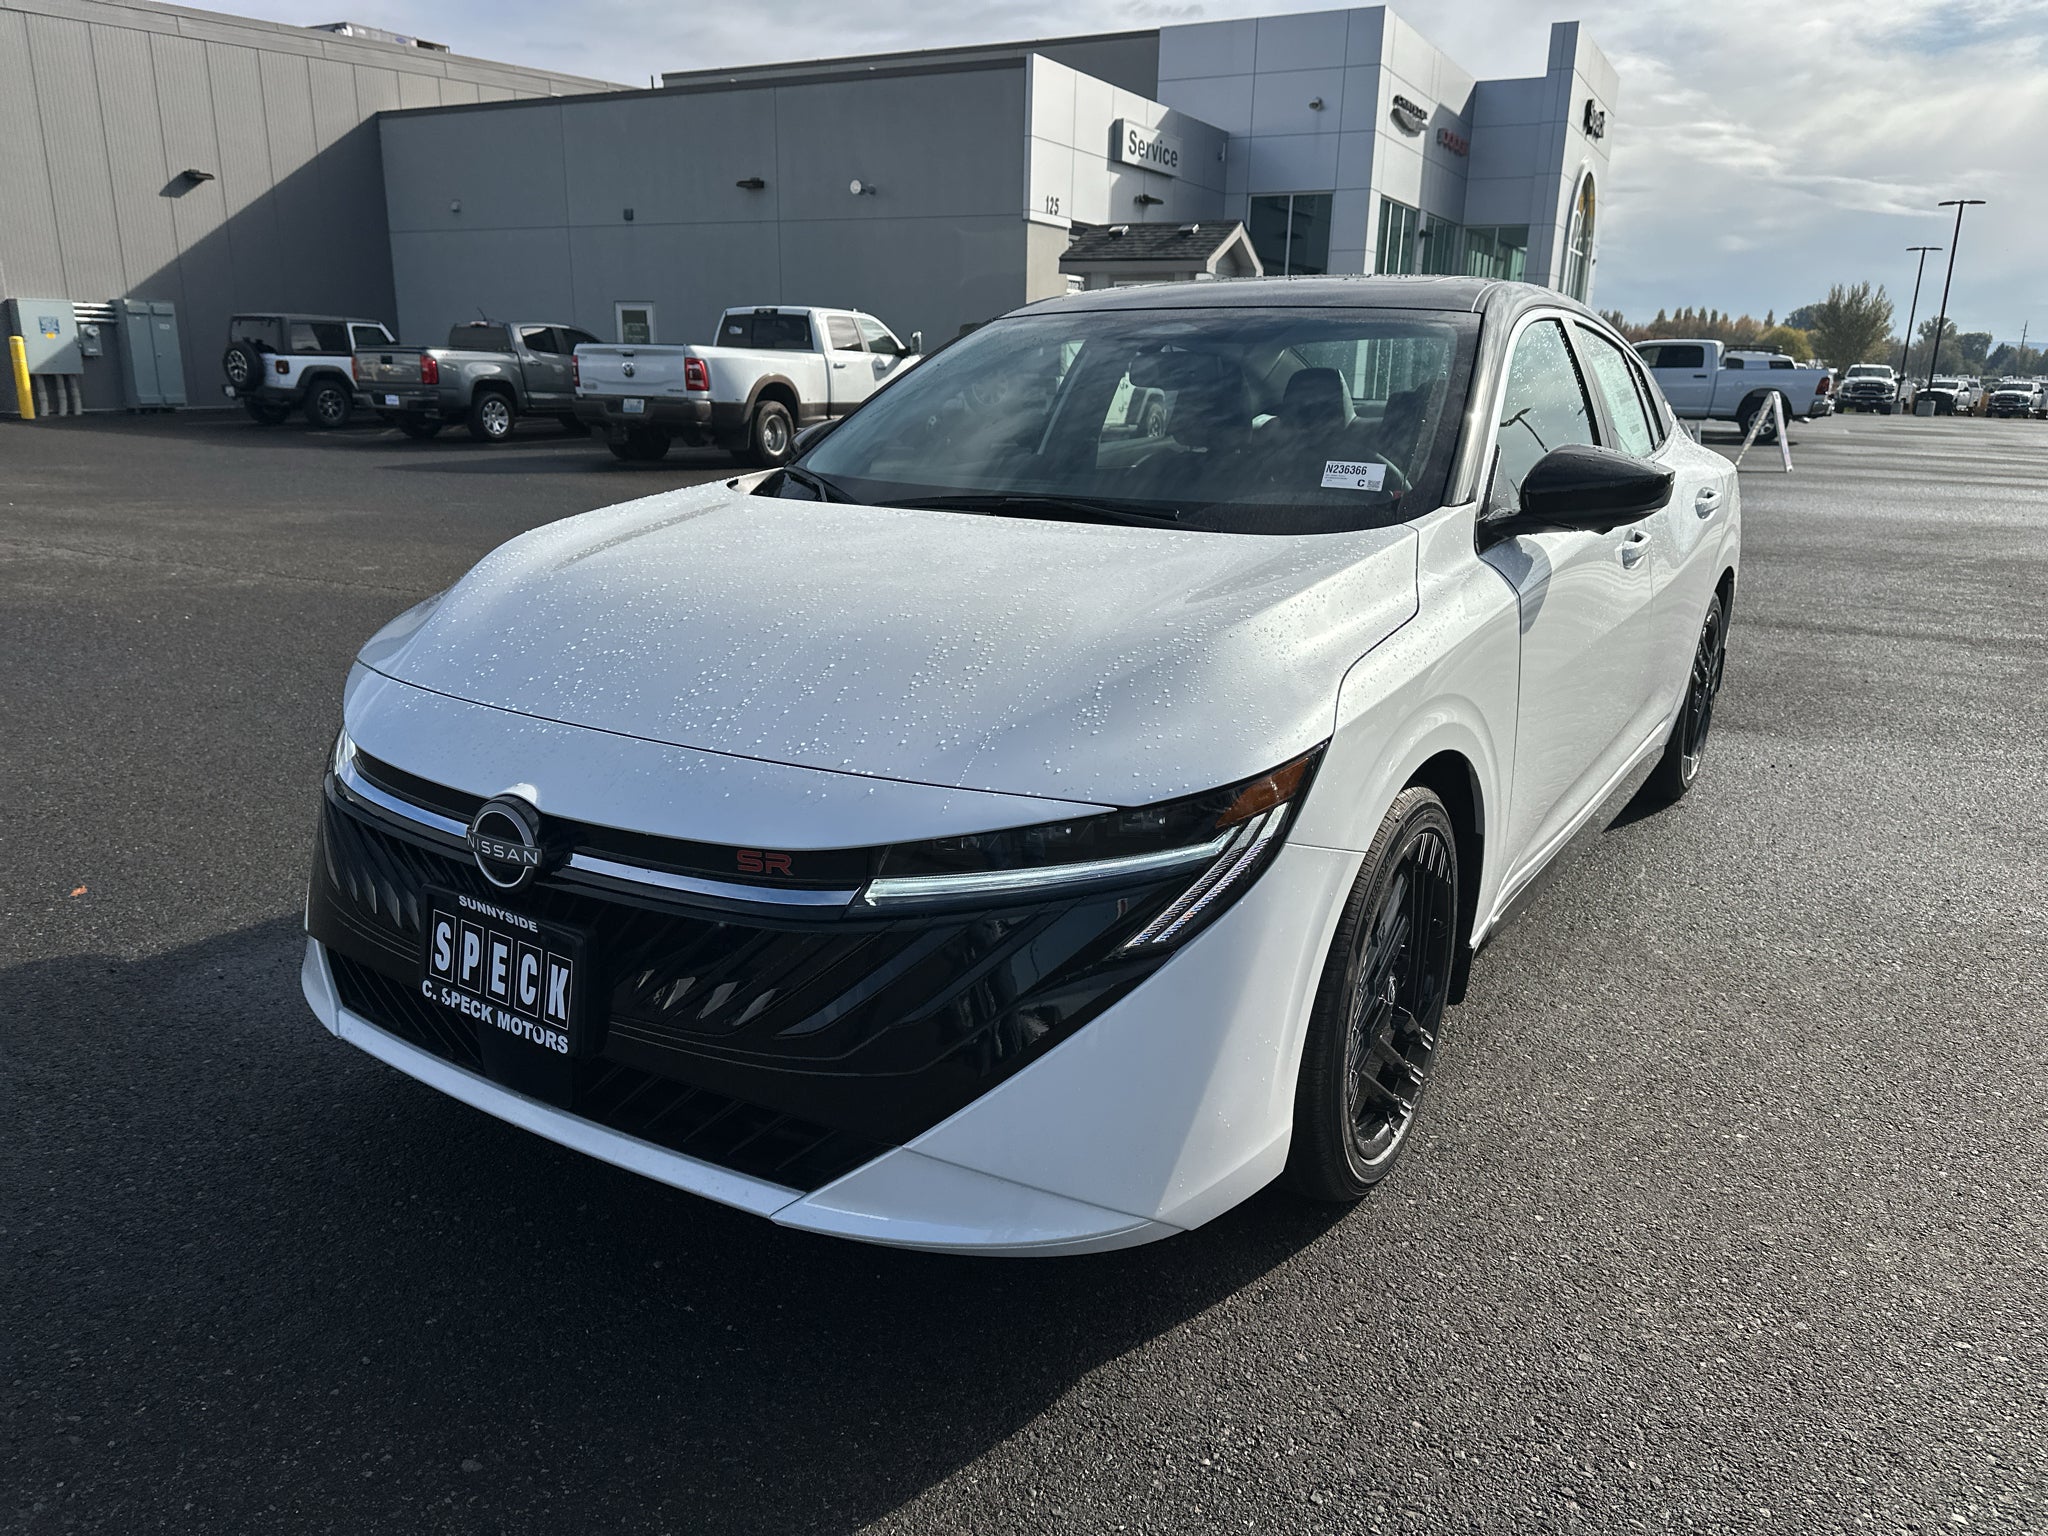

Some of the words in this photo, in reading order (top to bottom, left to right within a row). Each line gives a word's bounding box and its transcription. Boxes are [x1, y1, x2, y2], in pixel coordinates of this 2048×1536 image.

[1128, 129, 1179, 168] Service
[1045, 195, 1060, 216] 125
[1326, 464, 1367, 475] N236366
[1357, 479, 1365, 487] C
[467, 834, 538, 866] NISSAN
[736, 849, 794, 876] SR
[458, 895, 538, 933] SUNNYSIDE
[434, 921, 570, 1021] SPECK
[421, 979, 437, 1001] C.
[441, 987, 494, 1025] SPECK
[496, 1010, 569, 1055] MOTORS
